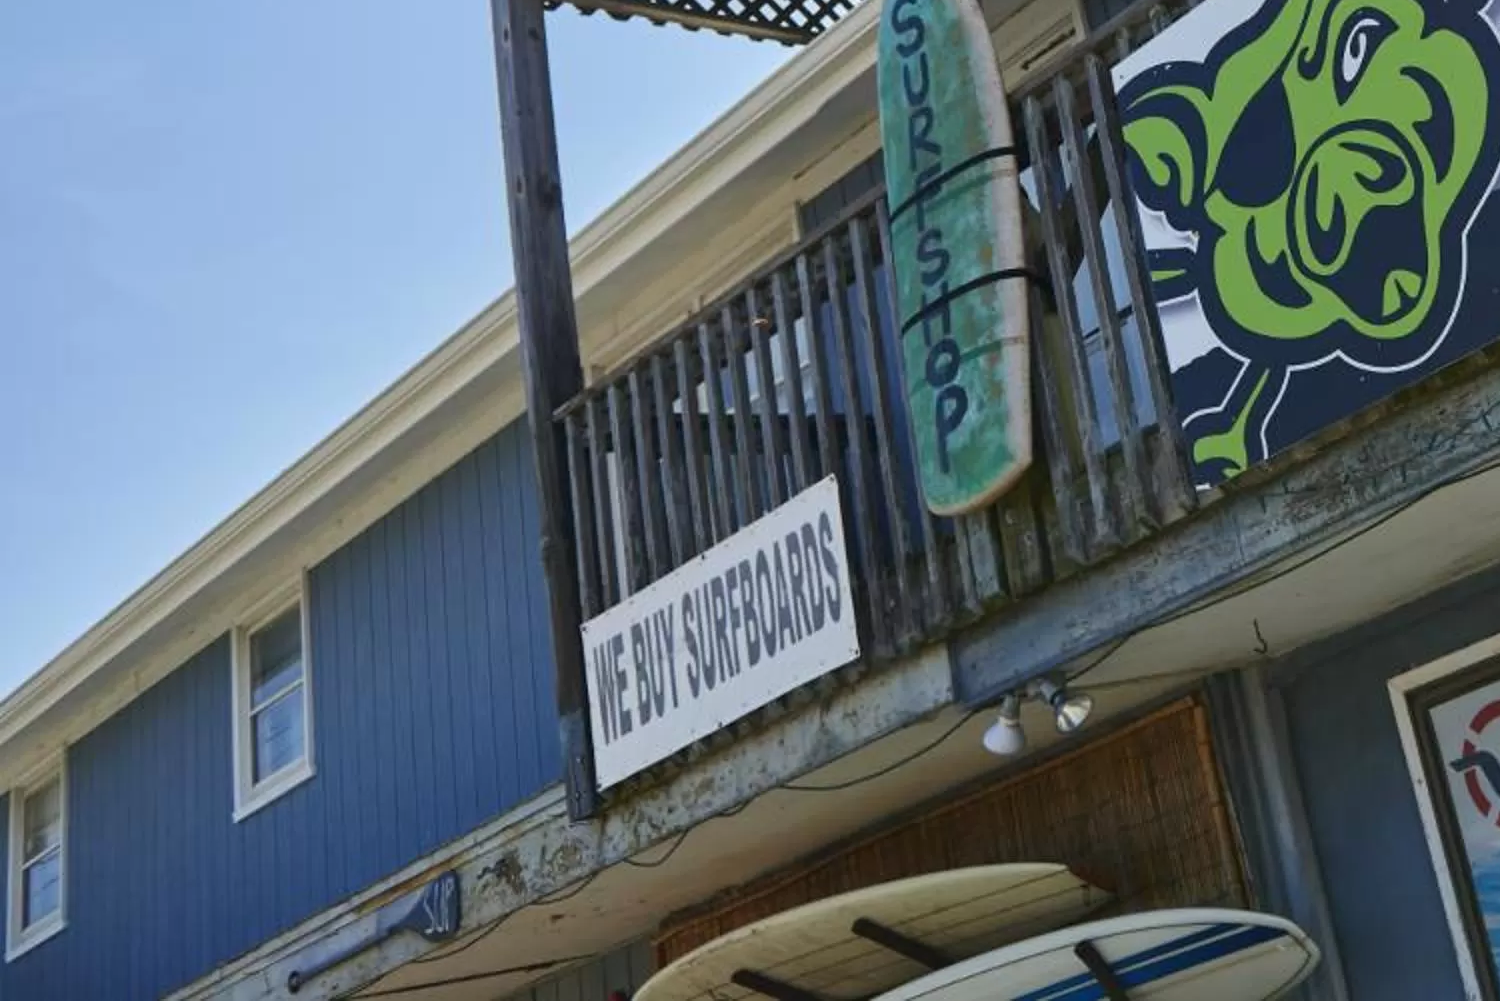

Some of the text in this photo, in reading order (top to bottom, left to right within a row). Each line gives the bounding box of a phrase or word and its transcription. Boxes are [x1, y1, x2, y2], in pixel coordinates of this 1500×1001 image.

[593, 510, 843, 747] WE BUY SURFBOARDS
